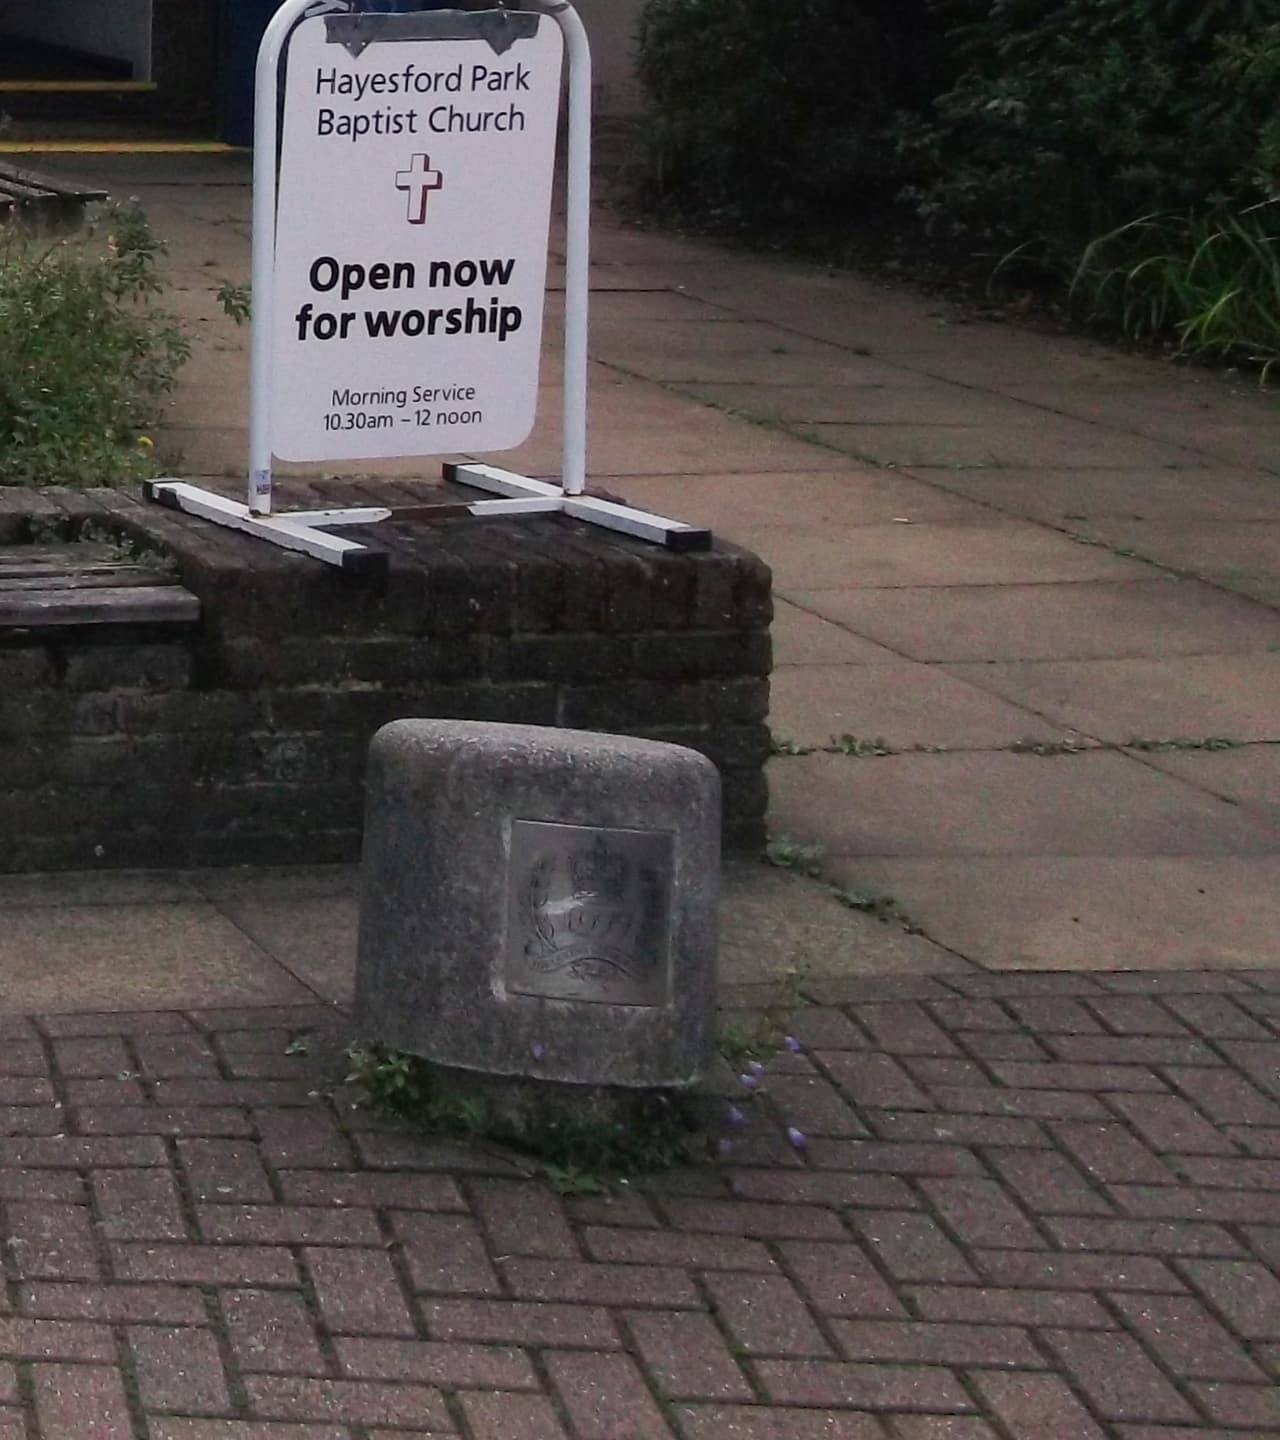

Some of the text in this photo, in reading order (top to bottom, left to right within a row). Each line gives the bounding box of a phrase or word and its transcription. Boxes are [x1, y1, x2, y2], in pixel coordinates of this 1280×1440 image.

[315, 62, 532, 102] Hayesford Park
[317, 103, 525, 143] Baptist Church
[309, 256, 516, 301] Open now
[295, 297, 523, 342] for worship
[331, 383, 476, 408] Morning Service
[322, 411, 394, 431] 10.30am
[436, 410, 483, 425] noon
